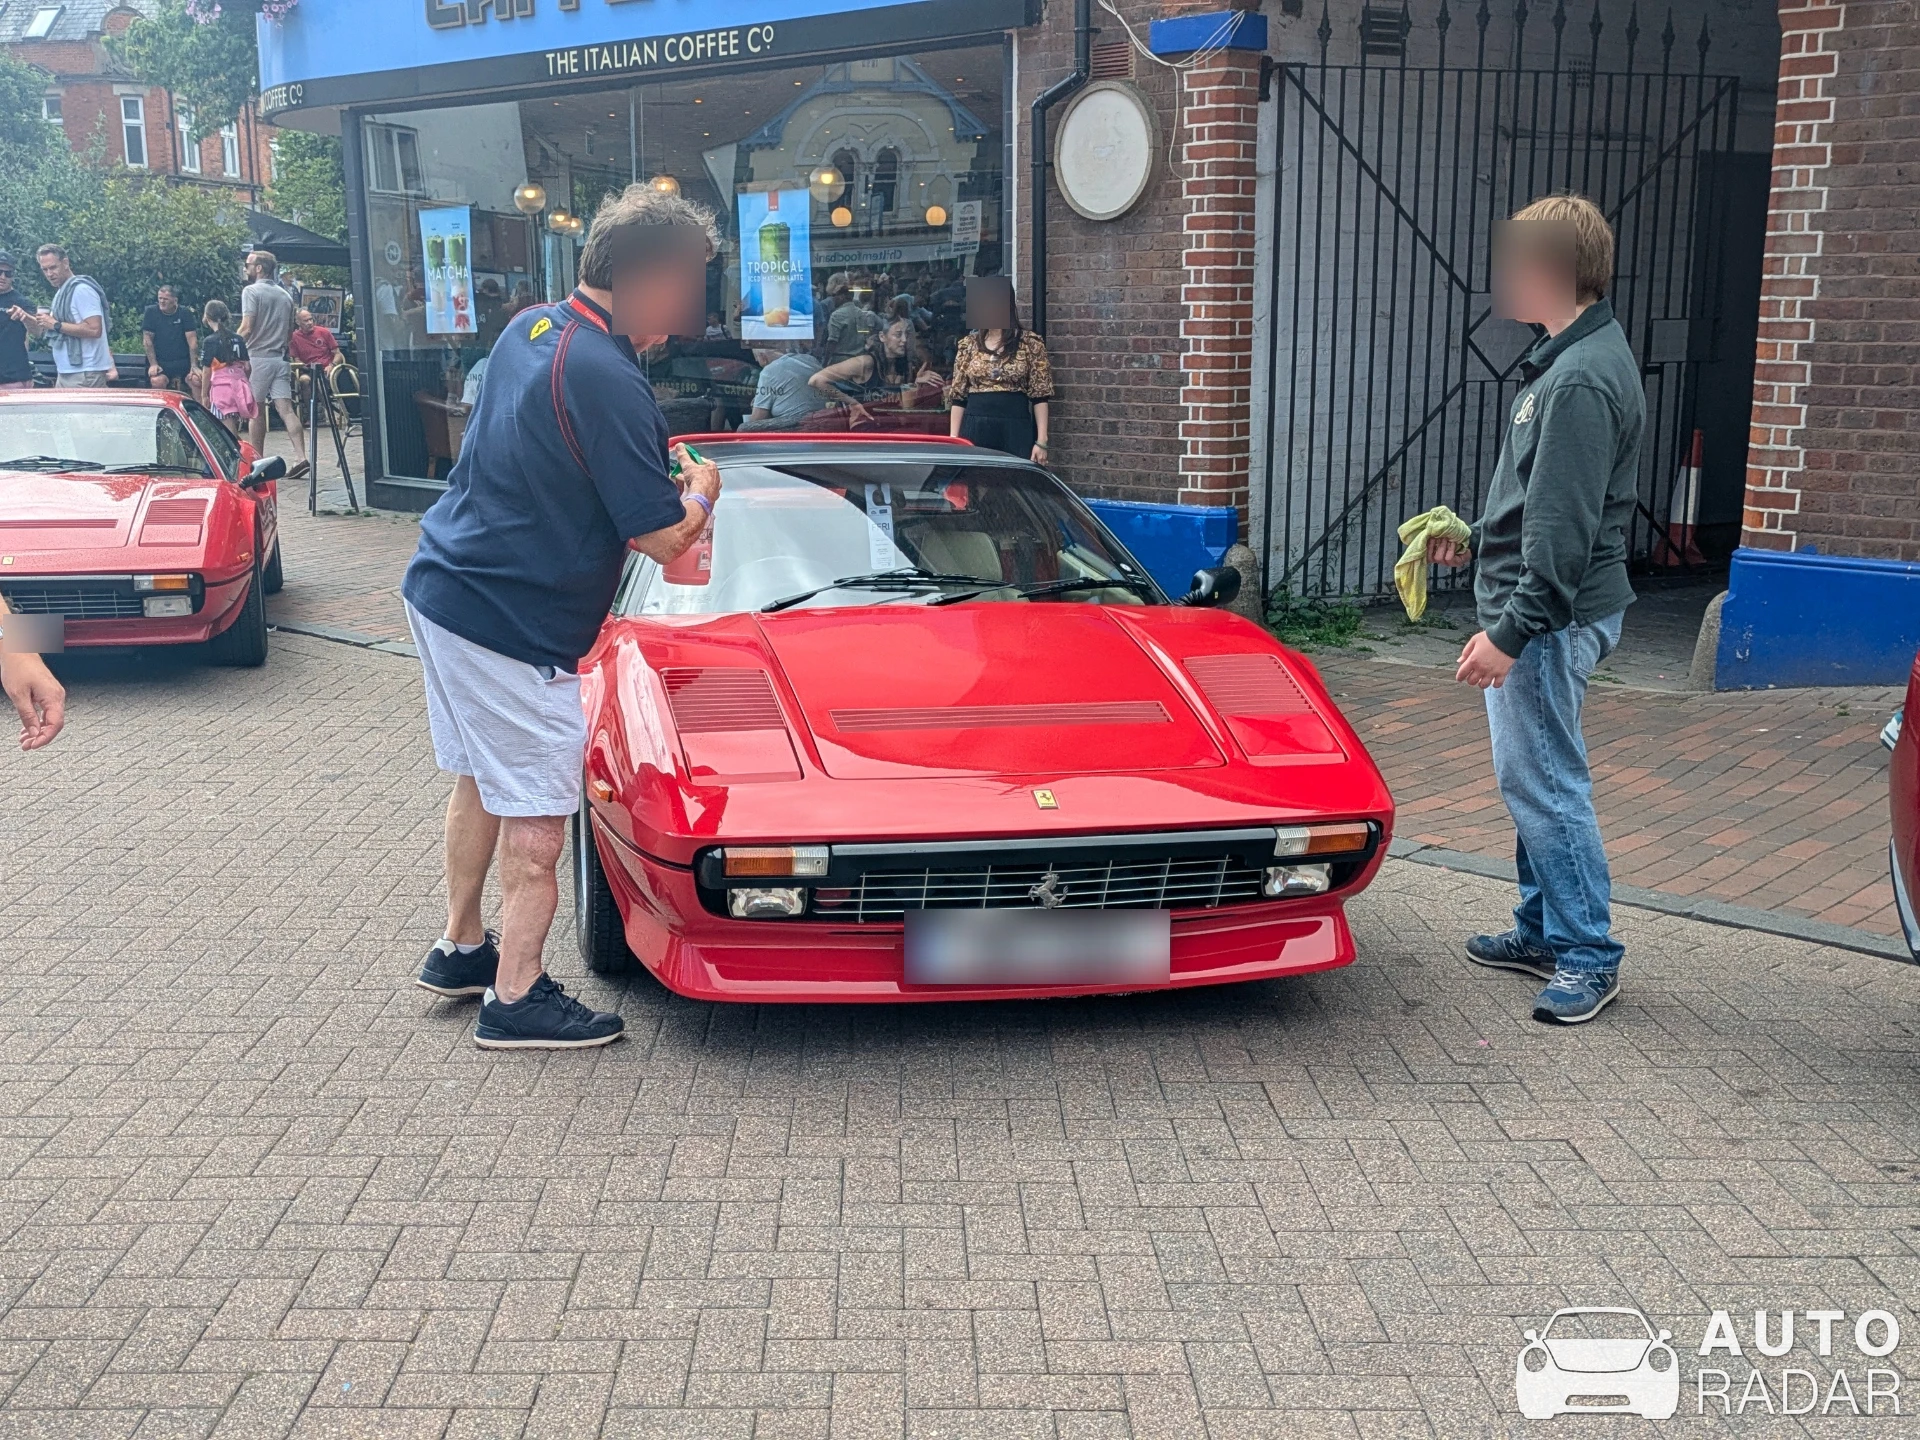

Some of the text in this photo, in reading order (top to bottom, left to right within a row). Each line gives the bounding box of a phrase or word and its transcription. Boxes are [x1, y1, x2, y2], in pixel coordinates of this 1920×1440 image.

[545, 50, 579, 76] THE
[584, 40, 658, 72] ITALIAN
[664, 30, 739, 63] COFFEE
[264, 86, 288, 111] COFFEE
[427, 265, 469, 281] MATCHA
[747, 260, 804, 274] TROPICAL
[761, 274, 786, 282] MATCHA
[786, 273, 804, 282] LATTE
